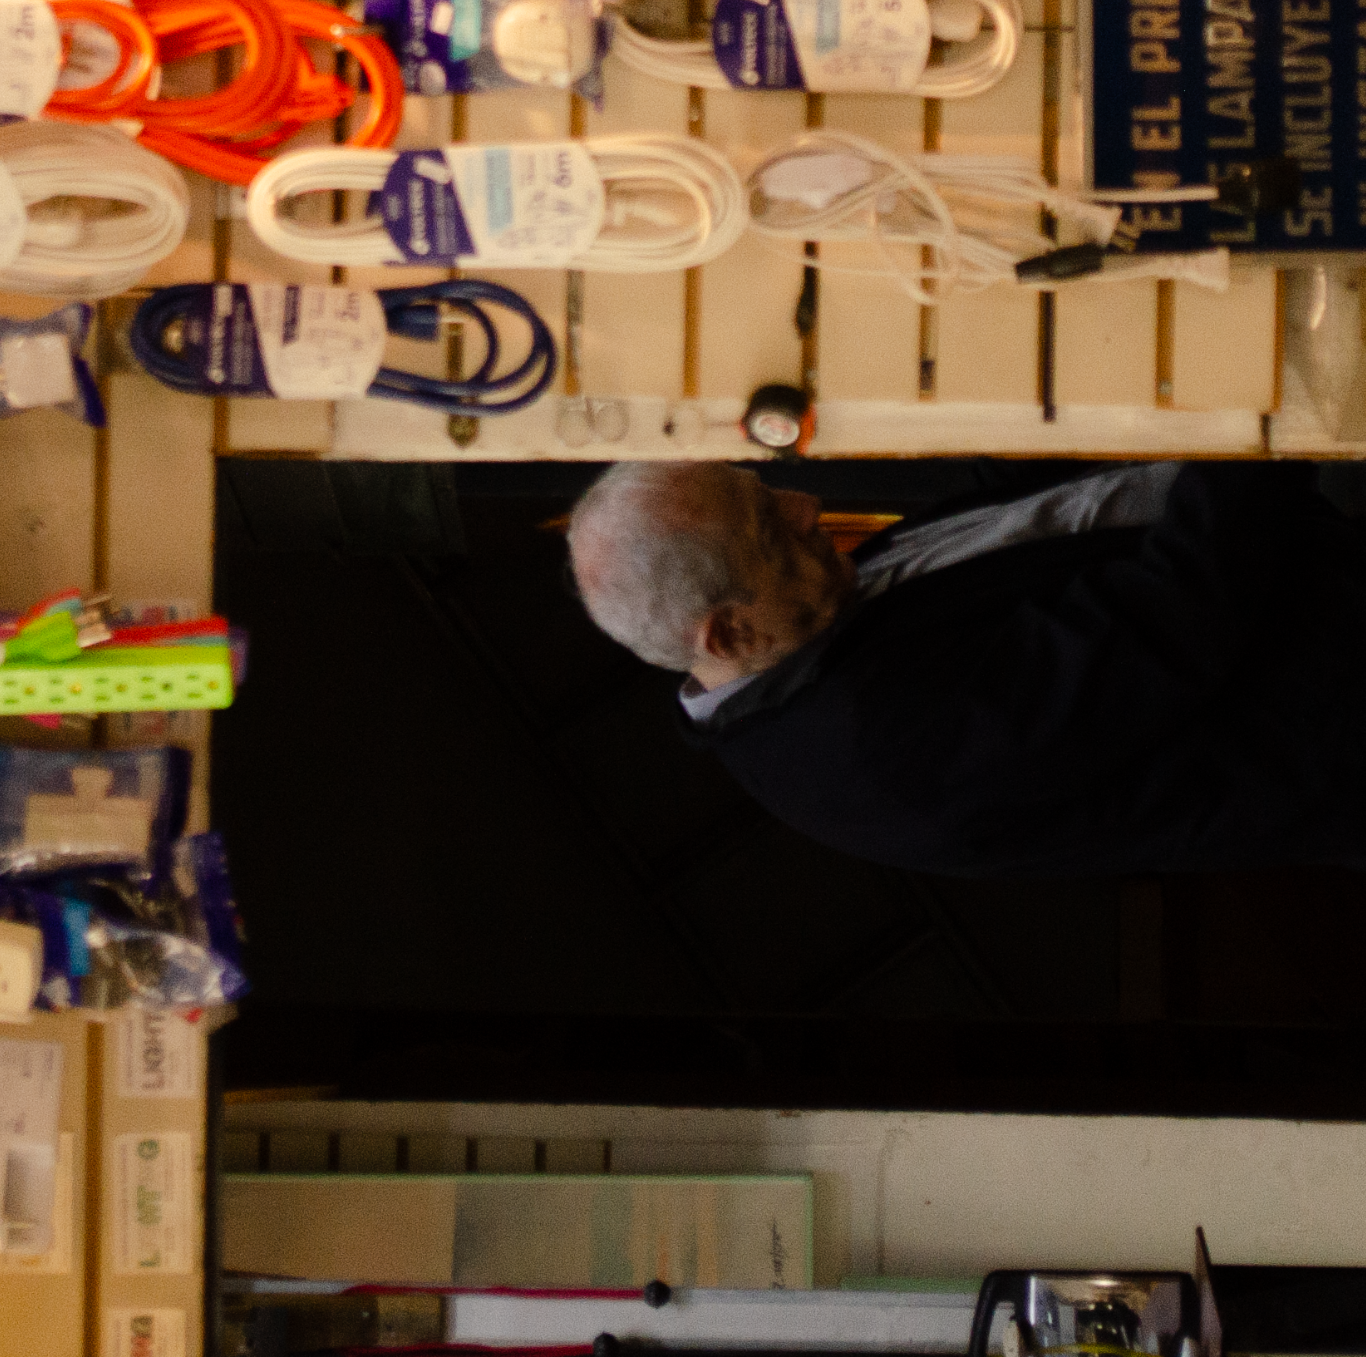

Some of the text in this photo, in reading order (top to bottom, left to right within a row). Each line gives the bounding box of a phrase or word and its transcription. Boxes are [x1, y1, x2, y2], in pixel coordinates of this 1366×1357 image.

[11, 5, 35, 40] 2m
[1132, 97, 1182, 151] EL
[553, 152, 573, 188] 6m
